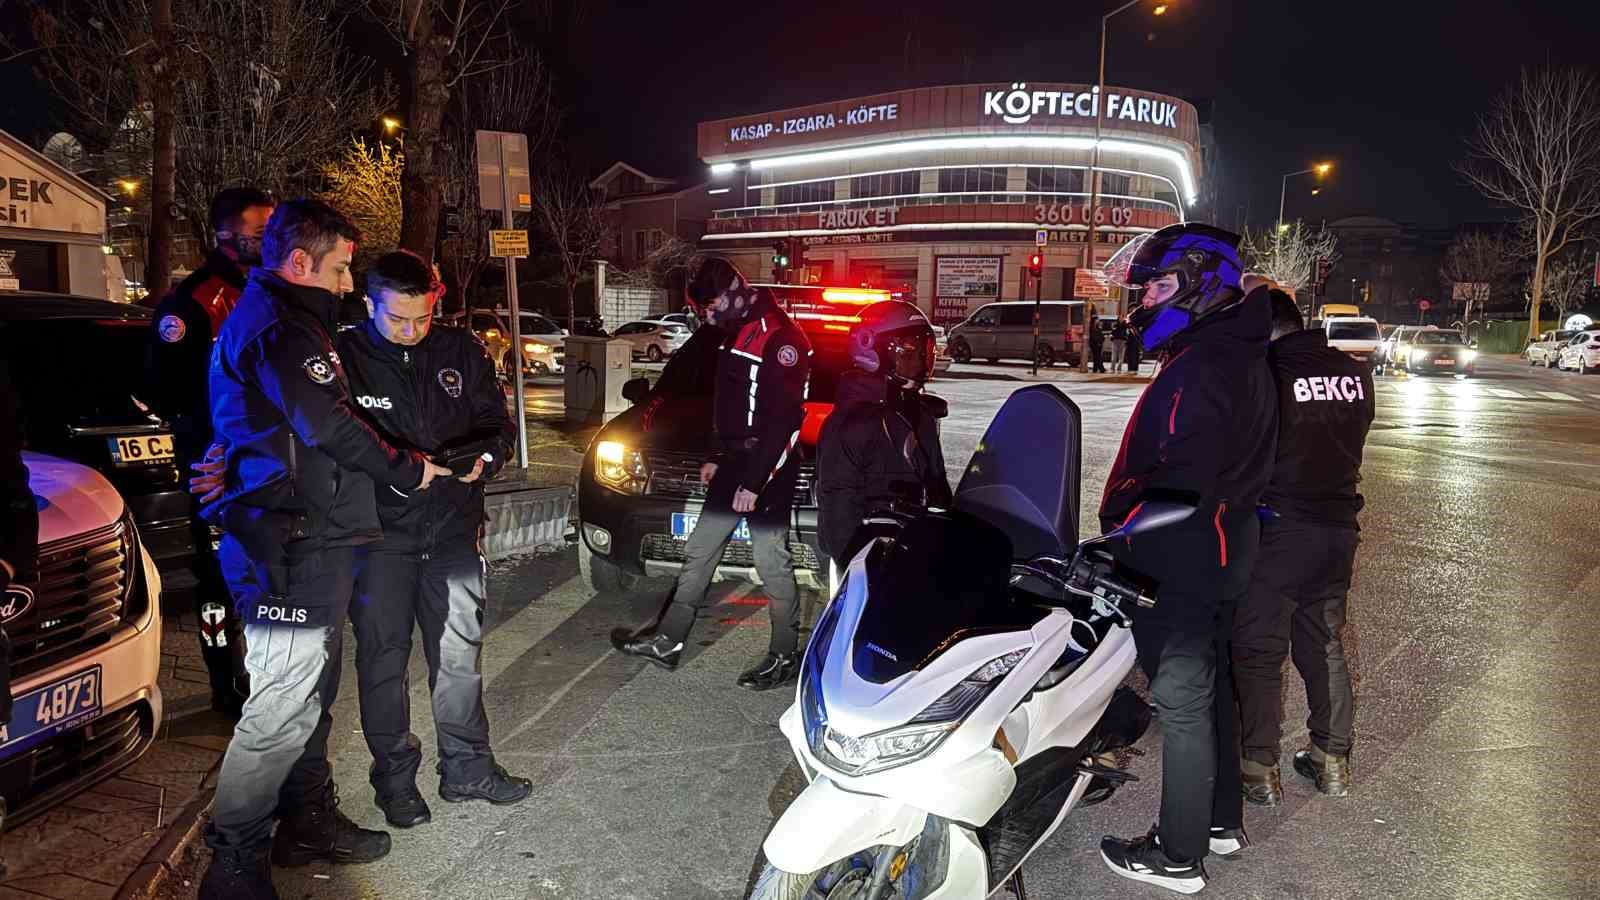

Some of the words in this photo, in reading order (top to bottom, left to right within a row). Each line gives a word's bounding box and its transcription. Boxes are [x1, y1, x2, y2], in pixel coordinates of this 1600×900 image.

[985, 82, 1100, 118] KÖFTECİ
[1106, 94, 1176, 128] FARUK
[731, 123, 773, 141] KASAP
[783, 113, 835, 135] IZGARA
[846, 104, 898, 125] KÖFTE
[818, 207, 870, 229] FARUK
[875, 206, 897, 225] ET
[1034, 203, 1073, 223] 360
[1081, 205, 1105, 224] 06
[1112, 206, 1133, 226] 09
[1047, 231, 1086, 242] AKET
[1293, 376, 1364, 402] BEKÇİ
[120, 438, 142, 458] 16
[865, 641, 898, 661] HONDA
[36, 673, 96, 725] 4873
